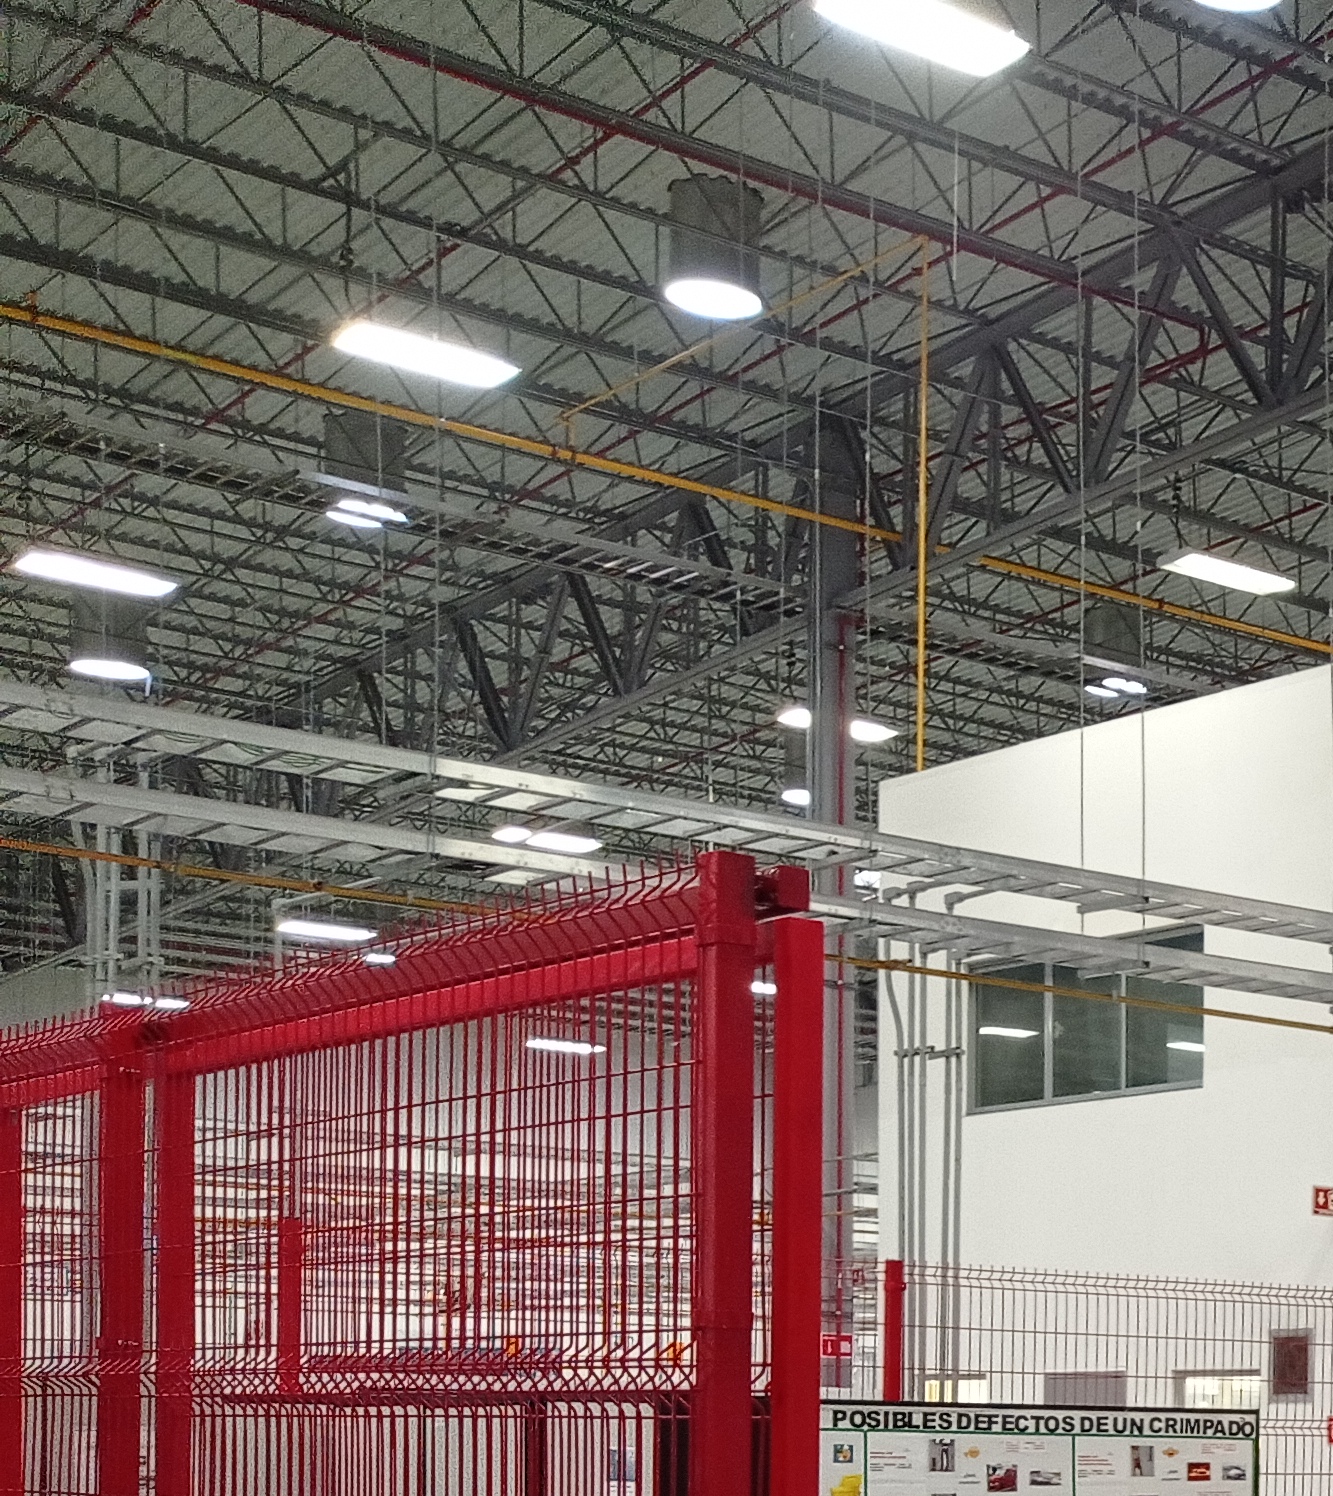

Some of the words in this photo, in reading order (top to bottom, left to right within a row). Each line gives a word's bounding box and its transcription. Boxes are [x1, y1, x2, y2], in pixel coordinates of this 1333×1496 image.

[832, 1409, 953, 1431] POSIBLES
[957, 1413, 1075, 1434] DEFECTOS
[1080, 1416, 1109, 1434] DE
[1113, 1416, 1144, 1435] UN
[1150, 1417, 1255, 1437] CRIMPADO
